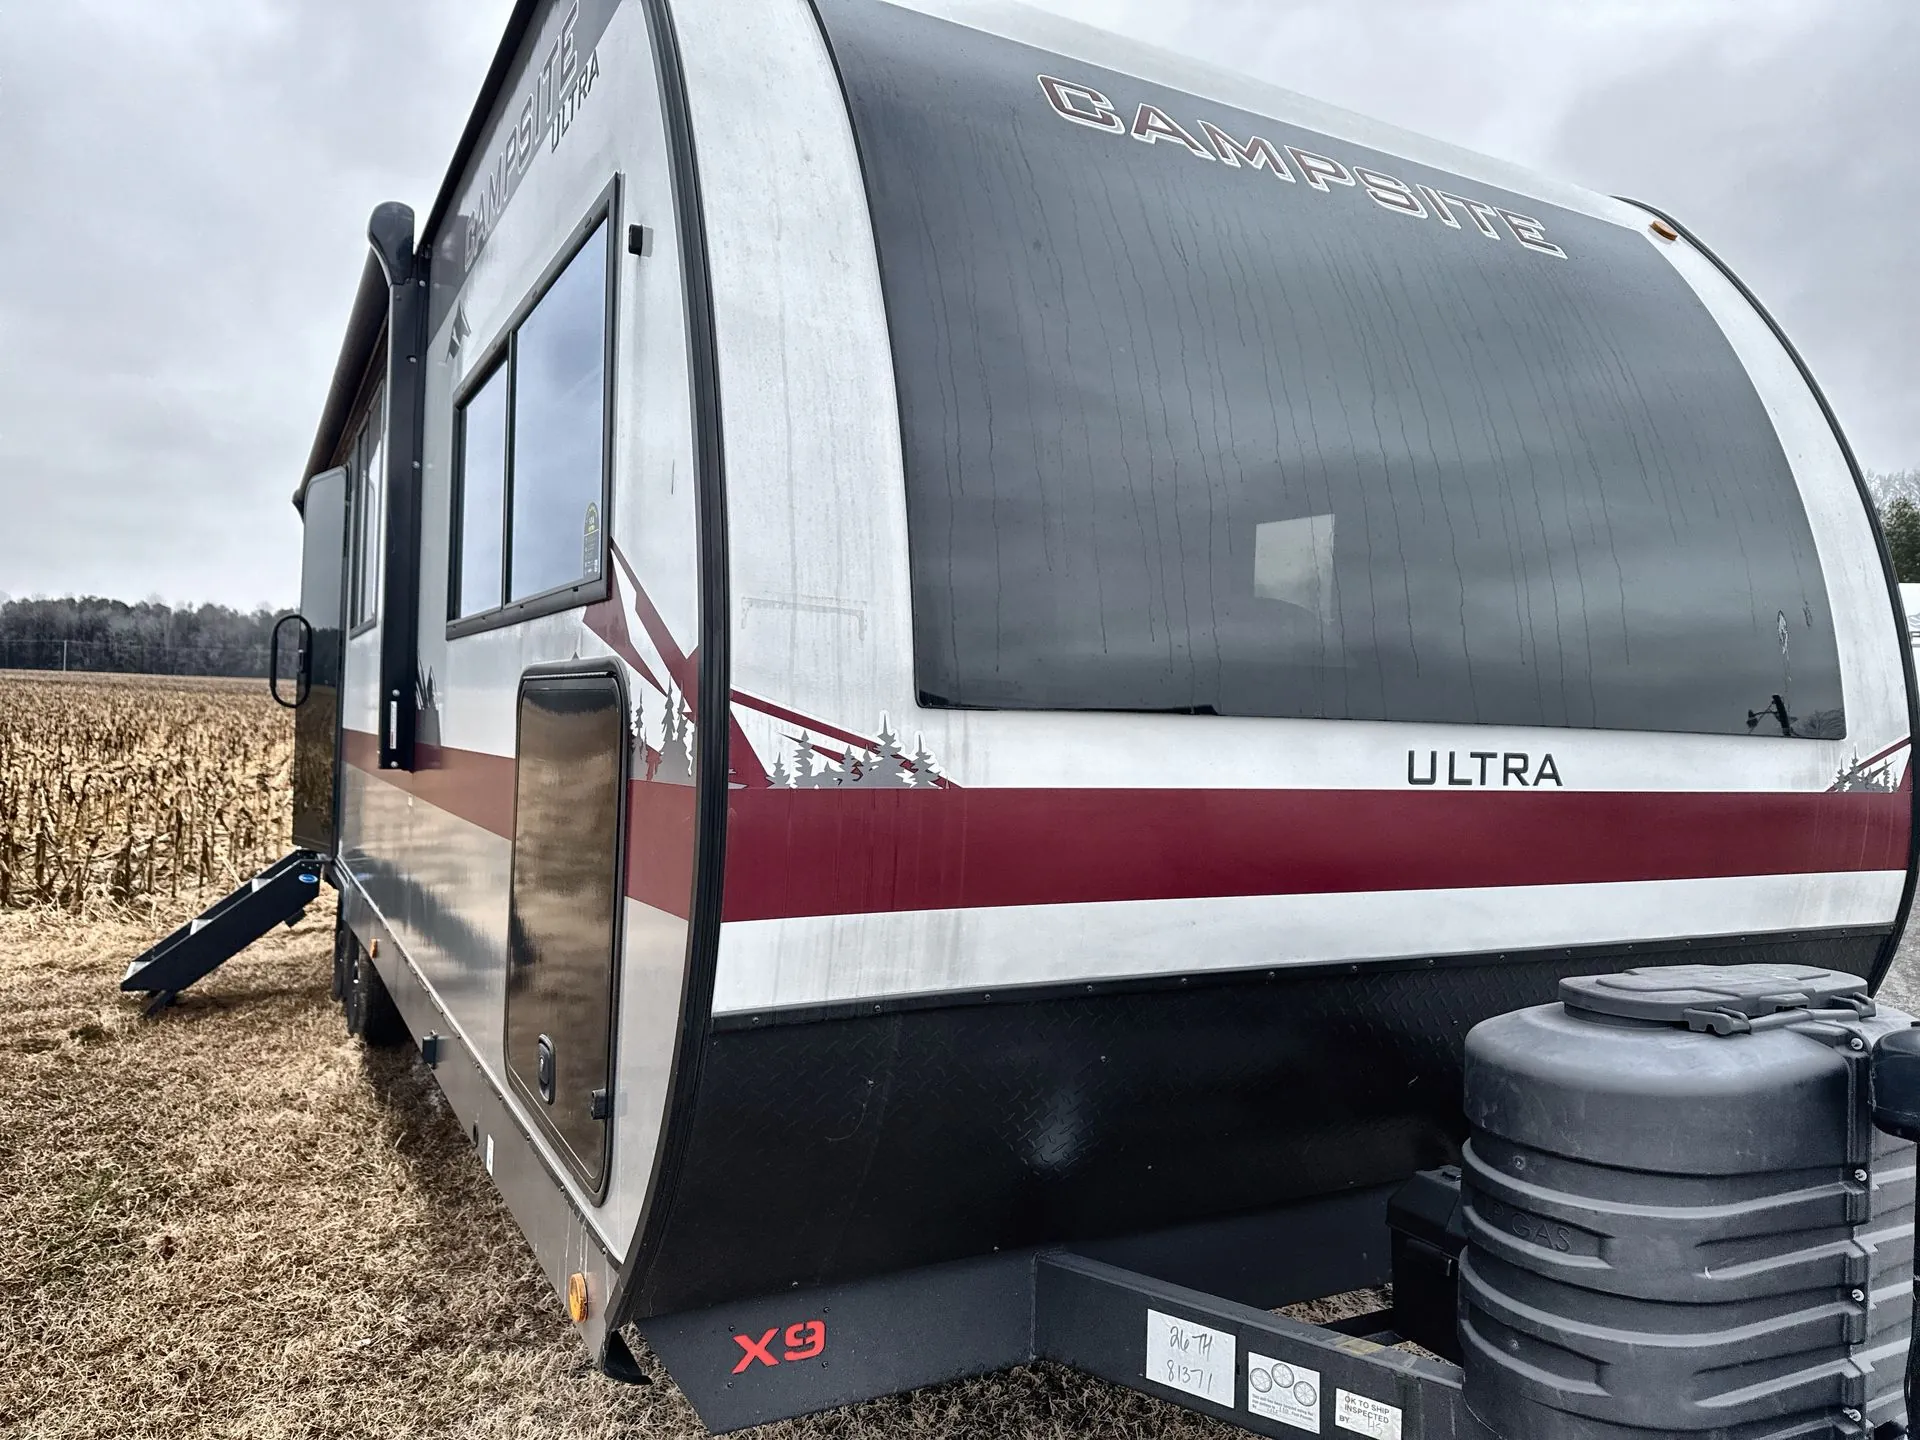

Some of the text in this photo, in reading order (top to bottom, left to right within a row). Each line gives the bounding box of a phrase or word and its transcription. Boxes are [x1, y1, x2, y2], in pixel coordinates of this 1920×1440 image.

[550, 47, 600, 154] ULTRA
[464, 0, 580, 273] CAMPSITE
[1037, 73, 1568, 260] CAMPSITE
[1407, 749, 1563, 787] ULTRA
[1511, 1211, 1573, 1253] GAS
[731, 1319, 827, 1375] X9
[1166, 1359, 1213, 1394] 81371
[1339, 1414, 1350, 1424] BY
[1344, 1395, 1390, 1415] OK TO SHIP
[1344, 1403, 1390, 1424] INSPECTED
